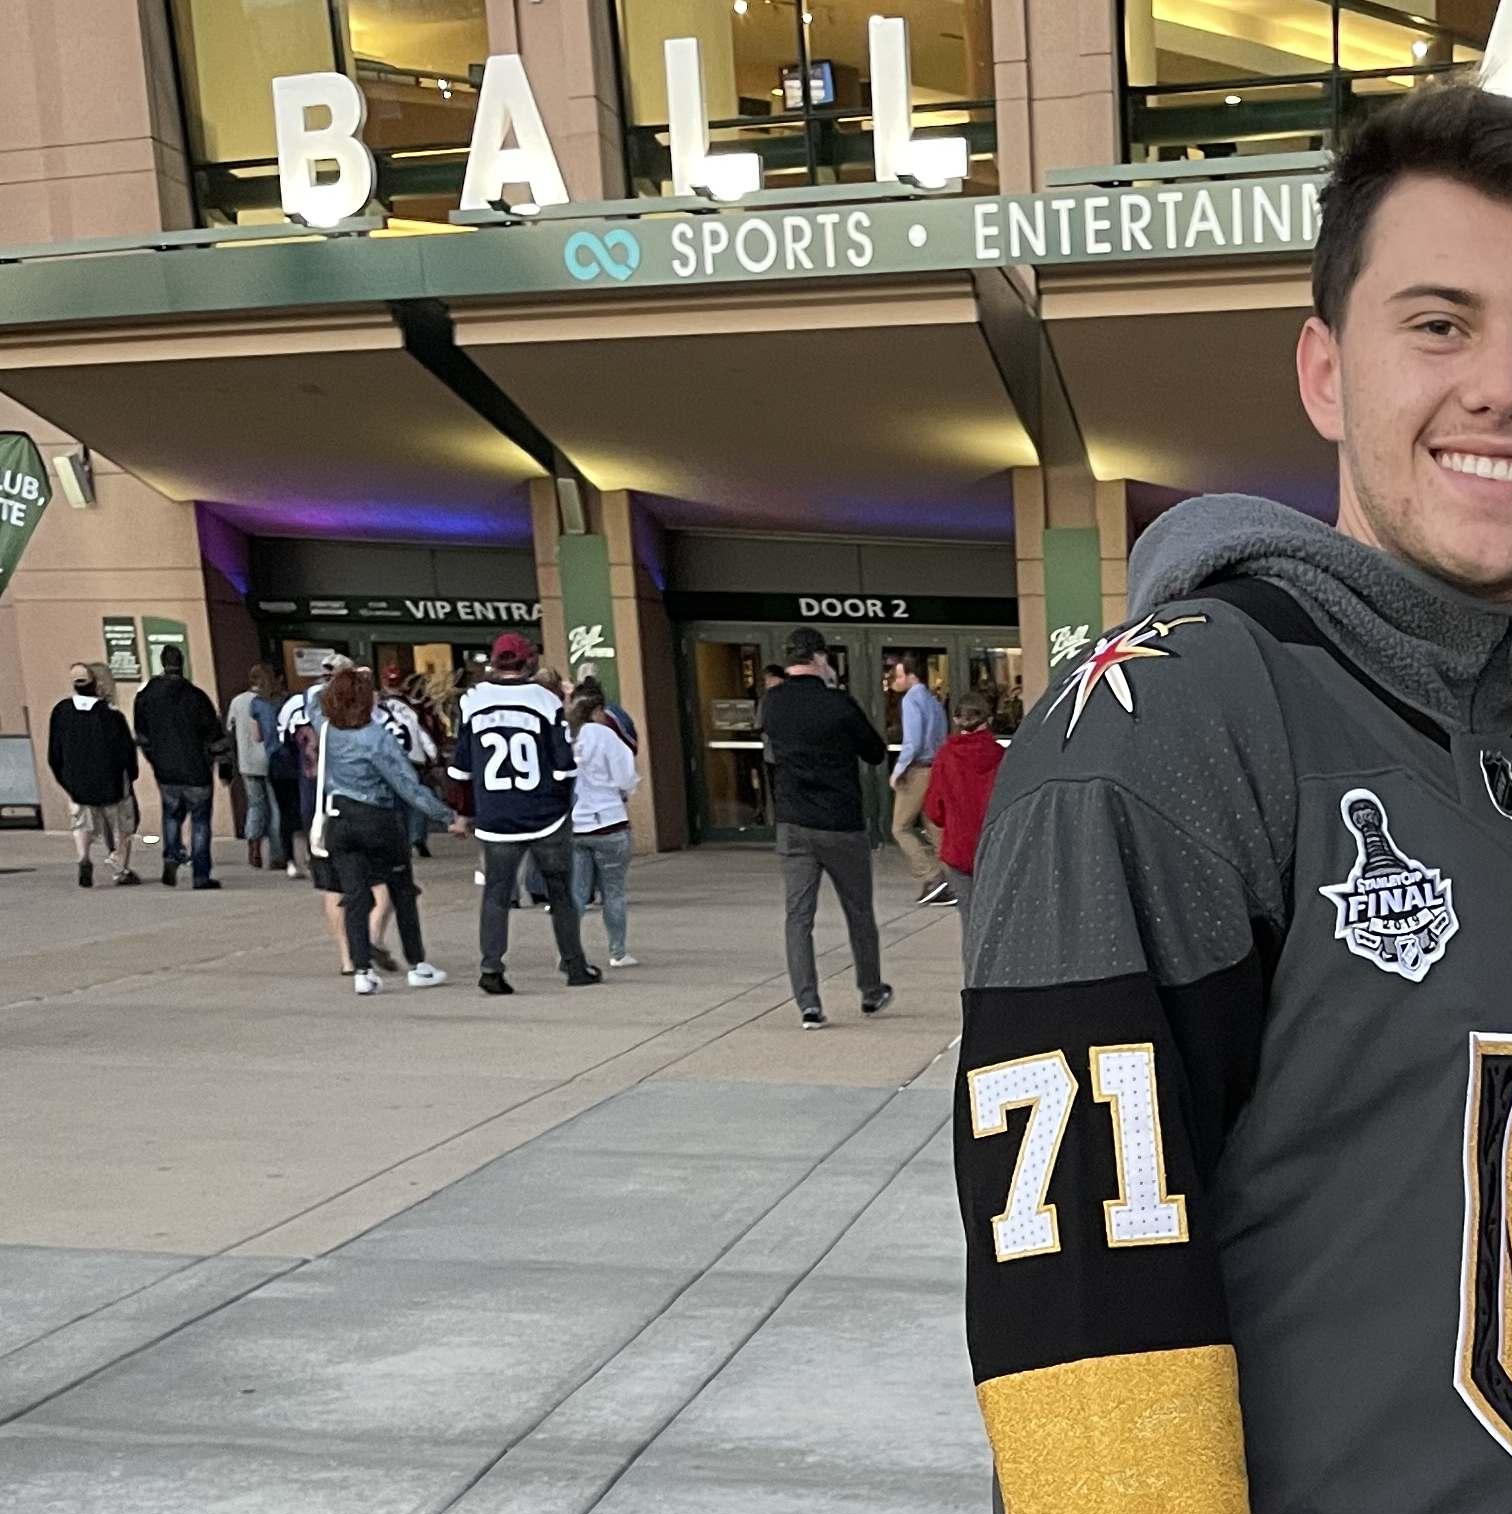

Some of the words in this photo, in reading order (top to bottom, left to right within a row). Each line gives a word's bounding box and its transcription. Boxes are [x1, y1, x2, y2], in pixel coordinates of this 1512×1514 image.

[272, 17, 969, 227] BALL
[670, 211, 873, 277] SPORTS
[0, 469, 45, 506] UB,
[405, 600, 451, 620] VIP
[799, 597, 884, 618] DOOR
[889, 600, 909, 618] 2
[480, 732, 541, 791] 29
[1348, 883, 1444, 922] FINAL
[967, 1042, 1189, 1263] 71
